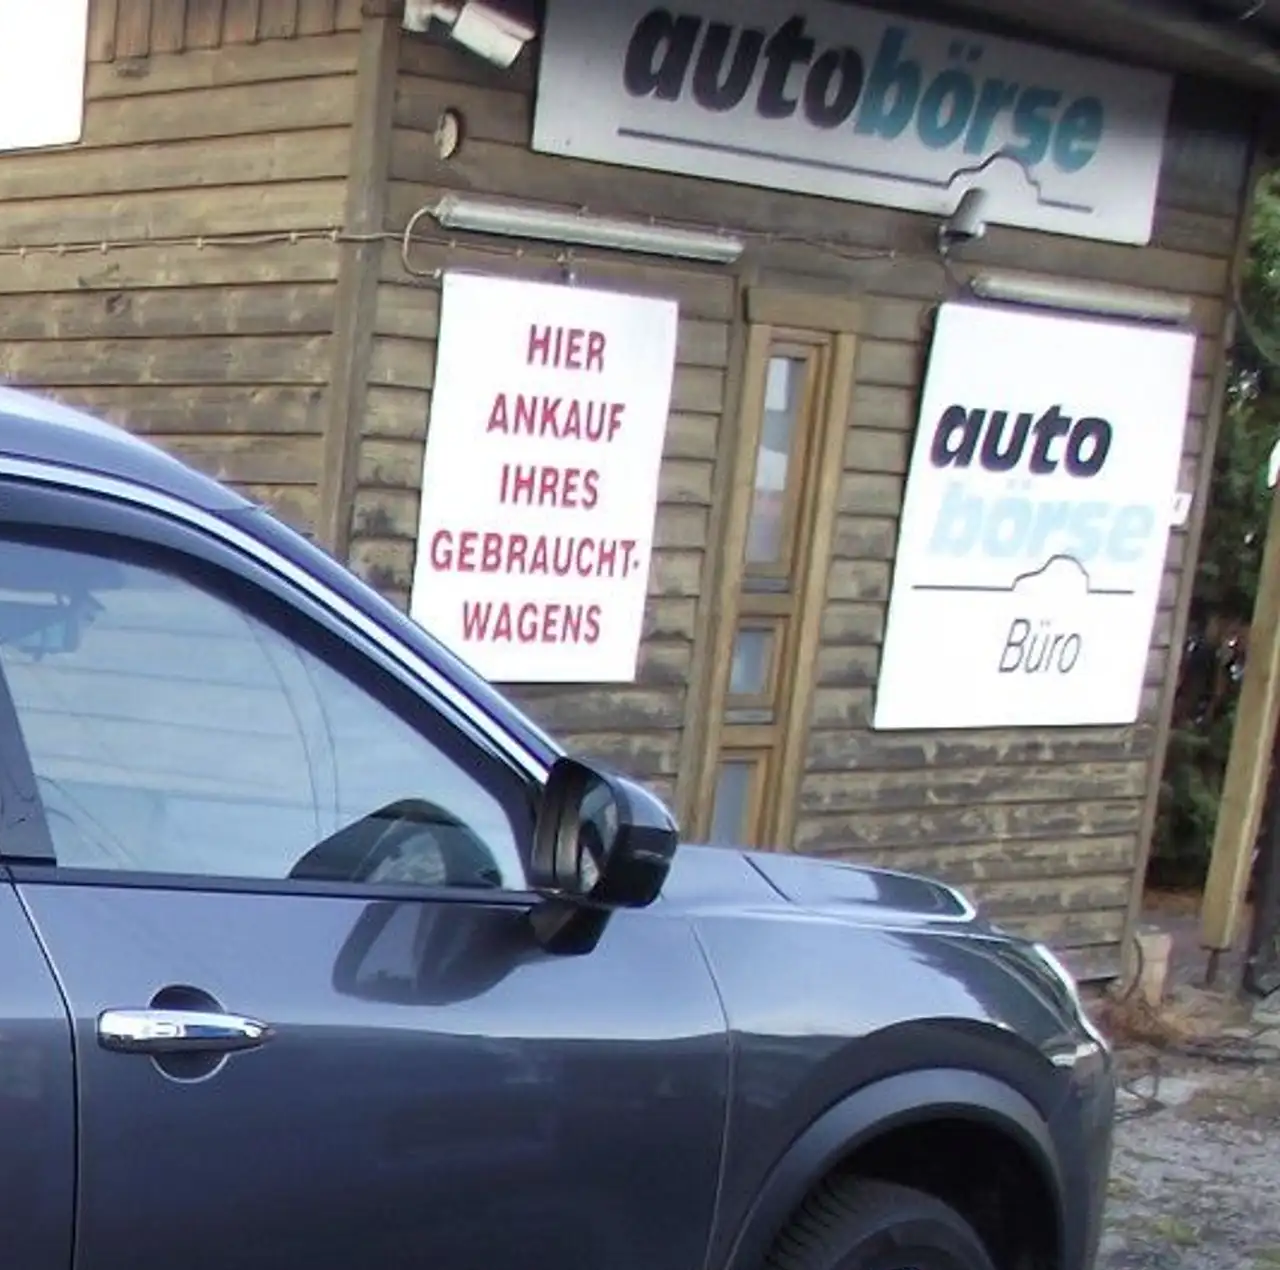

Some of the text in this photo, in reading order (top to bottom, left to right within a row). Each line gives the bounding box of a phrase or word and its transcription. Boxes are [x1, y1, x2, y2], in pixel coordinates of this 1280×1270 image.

[623, 7, 1105, 173] autobörse
[526, 323, 608, 373] HIER
[486, 392, 626, 443] ANKAUF
[930, 403, 1113, 478] auto
[499, 463, 601, 510] IHRES
[928, 479, 1157, 564] börse
[430, 529, 641, 578] GEBRAUCHT-
[462, 600, 602, 645] WAGENS
[998, 617, 1082, 674] Büro
